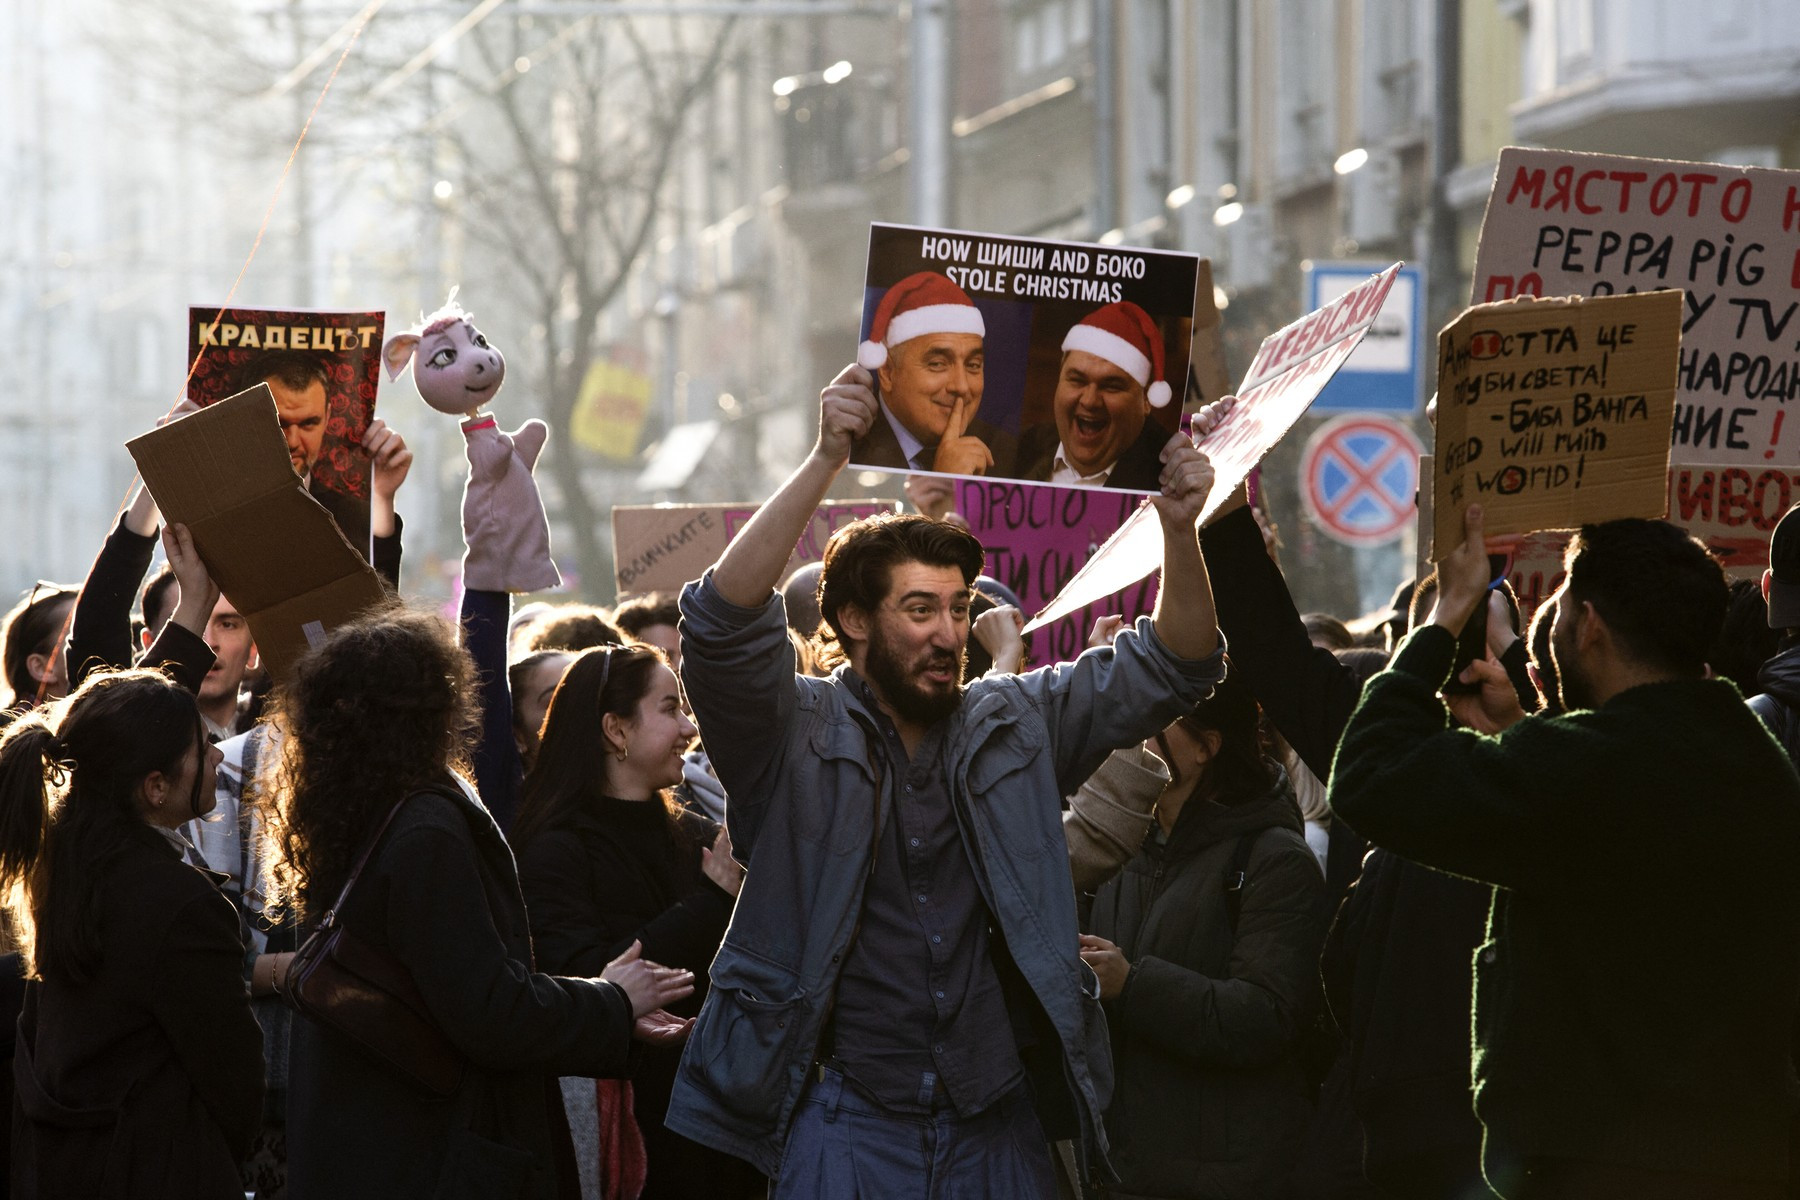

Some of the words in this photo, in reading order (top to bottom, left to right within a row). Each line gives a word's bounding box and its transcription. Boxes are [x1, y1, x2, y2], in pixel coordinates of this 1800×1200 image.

[1507, 165, 1753, 224] МЯСТОТО
[1782, 186, 1800, 233] Н
[921, 236, 971, 262] HOW
[976, 242, 1045, 270] ШИШИ
[1049, 250, 1090, 274] AND
[1096, 254, 1146, 280] БОКО
[1533, 225, 1674, 280] PEPPA
[945, 266, 1006, 293] STOLE
[1013, 273, 1122, 304] CHRISTMAS
[1597, 324, 1638, 354] ЩЕ
[1677, 348, 1800, 404] НАРОДН
[1501, 432, 1544, 458] will
[1668, 404, 1785, 460] НИЕ!
[962, 481, 1087, 532] ПРОСТО
[618, 510, 715, 586] ВСИЧКИТЕ
